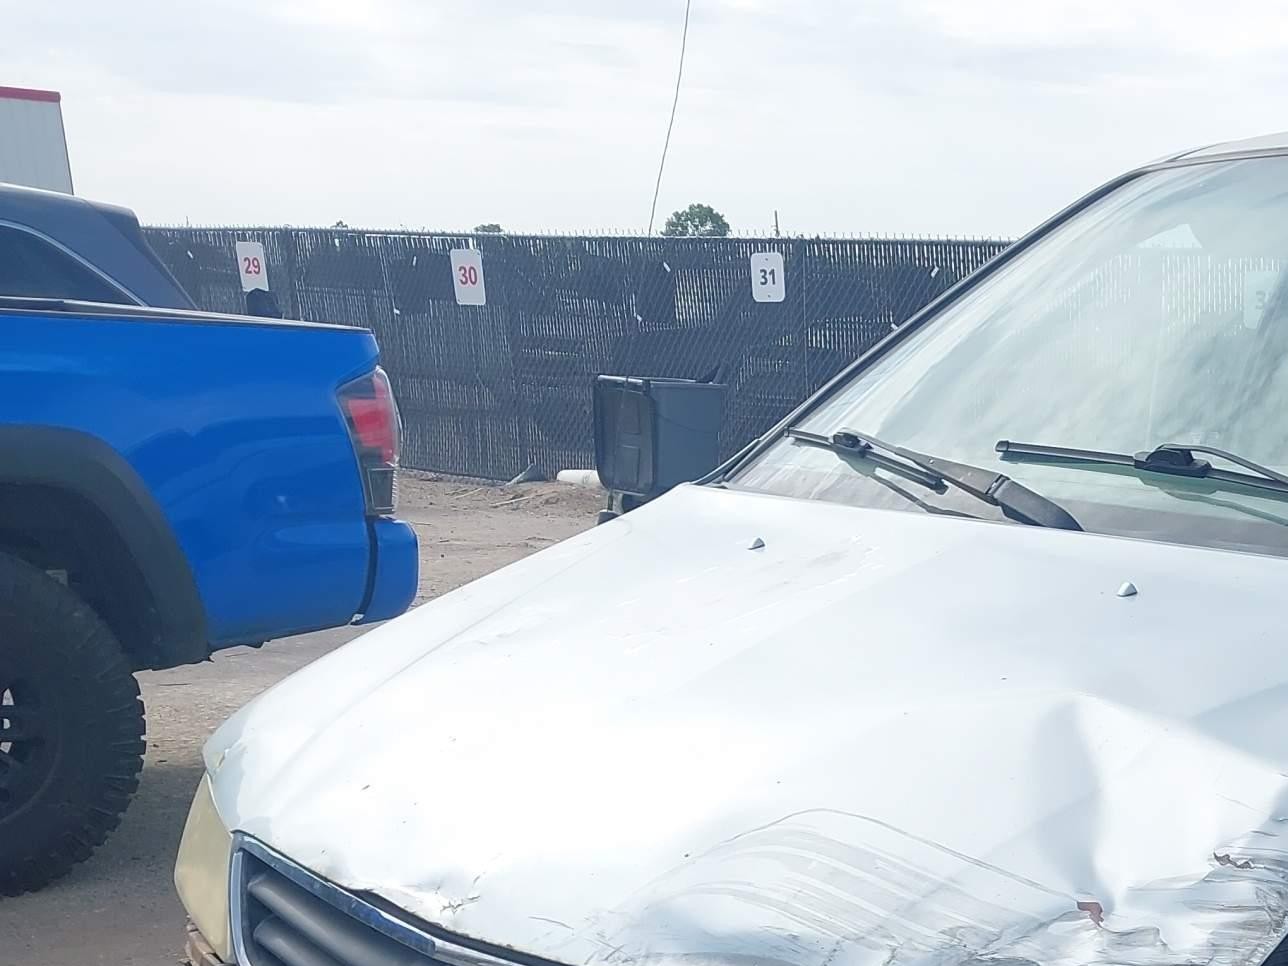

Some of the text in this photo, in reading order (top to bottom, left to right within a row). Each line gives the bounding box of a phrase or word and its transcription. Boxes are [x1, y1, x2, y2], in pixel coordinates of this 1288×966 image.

[243, 257, 262, 275] 29
[458, 265, 478, 286] 30
[759, 268, 776, 286] 31
